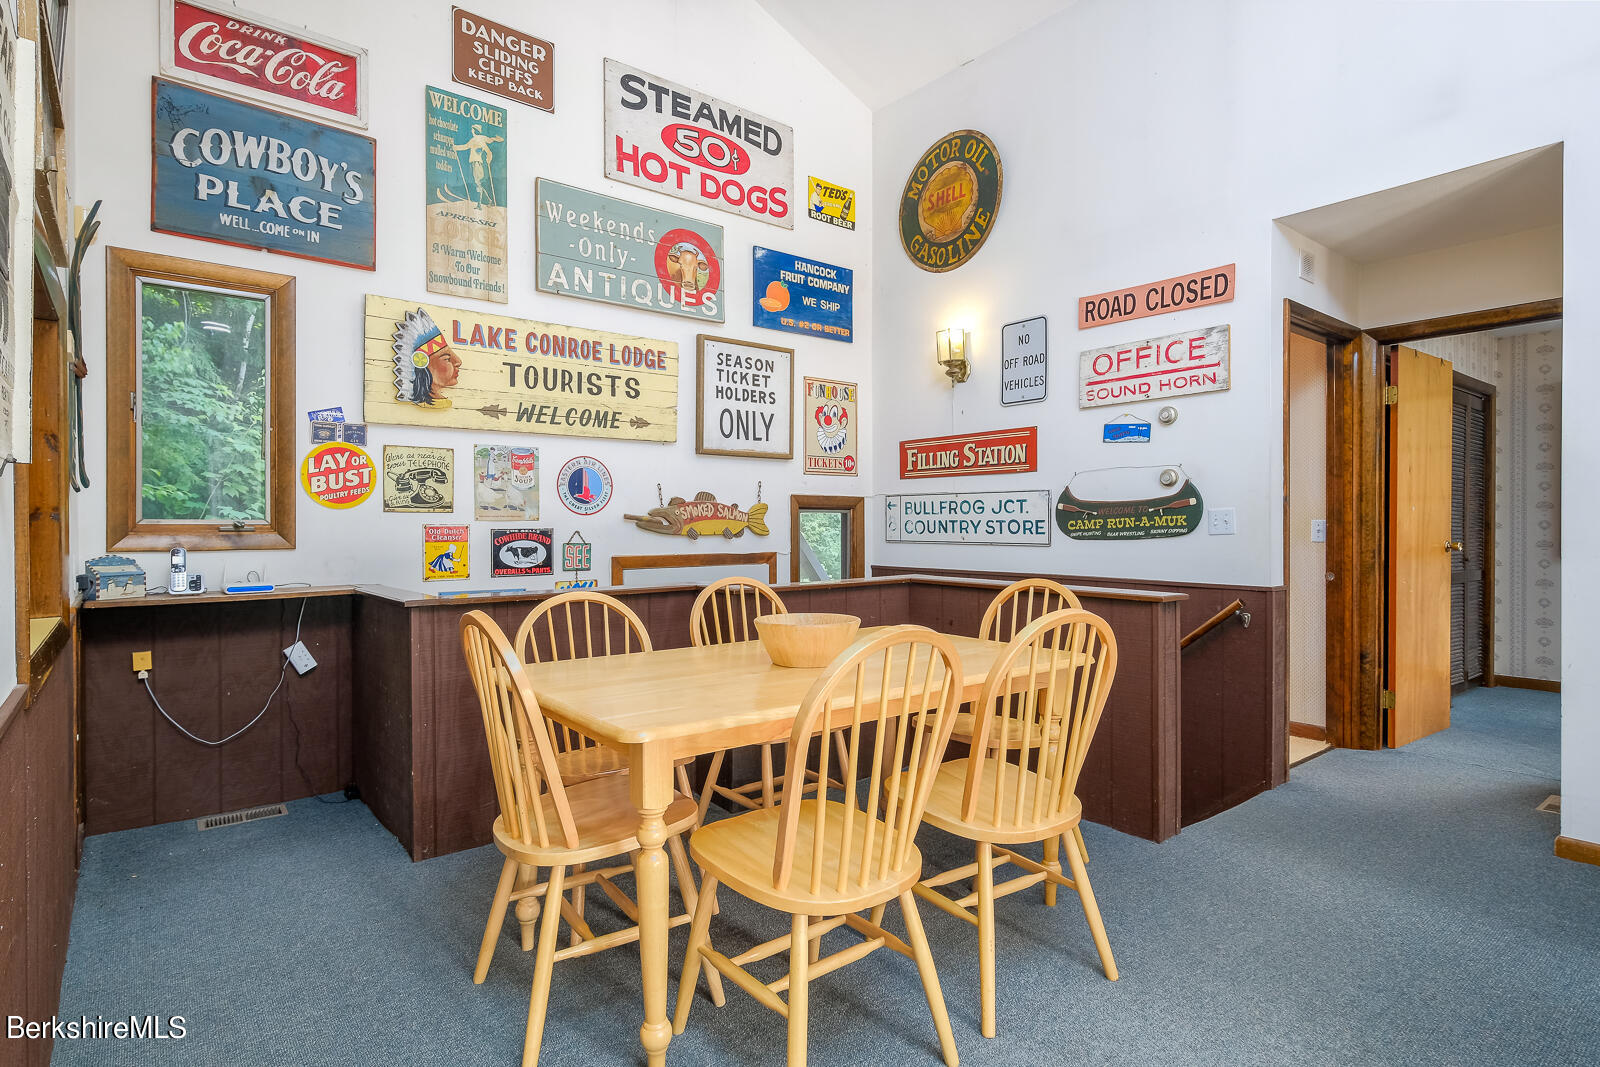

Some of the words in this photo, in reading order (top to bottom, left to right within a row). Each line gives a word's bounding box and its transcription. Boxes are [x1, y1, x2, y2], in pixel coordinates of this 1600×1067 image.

[225, 20, 288, 46] DRINK
[461, 17, 546, 62] DANGER
[178, 21, 349, 101] Coca-Cola
[472, 41, 539, 74] SLIDING
[468, 67, 504, 86] KEEP
[508, 81, 543, 100] BACK
[478, 58, 533, 86] CLIFFS
[429, 90, 503, 128] WELCOME
[620, 73, 783, 157] STEAMED
[673, 127, 740, 171] 50¢
[170, 127, 364, 206] COWBOY'S
[616, 134, 691, 190] HOT
[701, 171, 789, 218] DOGS
[908, 138, 961, 201] MOTOR
[964, 139, 989, 172] OIL
[196, 173, 343, 230] PLACE
[823, 186, 849, 201] TED'S
[928, 183, 967, 211] SHELL
[546, 200, 656, 246] Weekends
[810, 209, 832, 222] ROOT
[833, 217, 853, 229] BEER
[307, 230, 320, 243] IN
[910, 207, 991, 265] GASOLINE
[432, 243, 441, 253] A
[441, 243, 466, 259] Warm
[467, 249, 502, 266] Welcome
[428, 271, 473, 289] Snowbound
[455, 261, 465, 273] To
[465, 262, 480, 275] Our
[795, 260, 837, 279] HANCOCK
[547, 262, 718, 317] ANTIQUES
[780, 270, 806, 285] FRUIT
[807, 276, 850, 295] COMPANY
[802, 295, 817, 308] WE
[820, 300, 841, 312] SHIP
[1085, 293, 1137, 323] ROAD
[1145, 272, 1229, 312] CLOSED
[780, 317, 796, 327] U.S.
[811, 322, 822, 332] OR
[823, 325, 850, 337] BETTER
[452, 319, 518, 352] LAKE
[525, 331, 603, 363] CONROE
[608, 343, 667, 371] LODGE
[1018, 333, 1030, 346] NO
[717, 352, 775, 373] SEASON
[1004, 357, 1020, 370] OFF
[1023, 352, 1045, 367] ROAD
[1092, 336, 1206, 376] OFFICE
[502, 361, 642, 400] TOURISTS
[716, 368, 771, 388] TICKET
[1004, 375, 1045, 391] VEHICLES
[1085, 382, 1151, 402] SOUND
[1159, 372, 1217, 392] HORN
[715, 385, 777, 405] HOLDERS
[807, 382, 855, 402] FUNHOUSE
[516, 402, 622, 430] WELCOME
[719, 408, 775, 442] ONLY
[308, 451, 351, 474] LAY
[351, 455, 367, 466] OR
[408, 460, 450, 471] TELEPHONE
[807, 457, 842, 468] TICKETS
[906, 449, 960, 471] FILLING
[963, 443, 1027, 467] STATION
[310, 467, 373, 493] BUST
[560, 459, 581, 486] EASTERN
[583, 459, 597, 467] AIR
[597, 466, 611, 486] LINES
[320, 490, 349, 501] POULTRY
[350, 487, 370, 496] FEEDS
[569, 500, 583, 511] GREAT
[680, 503, 715, 519] SMOKED
[717, 505, 748, 523] SALMON
[904, 499, 985, 515] BULLFROG
[991, 499, 1029, 515] JCT.
[1097, 505, 1135, 515] WELCOME
[1138, 505, 1149, 513] TO
[904, 519, 982, 535] COUNTRY
[985, 518, 1046, 535] STORE
[1067, 519, 1103, 530] CAMP
[1106, 515, 1188, 529] RUN-A-MUK
[494, 533, 527, 546] COWHIDE
[528, 533, 552, 545] BRAND
[565, 544, 589, 568] SEE
